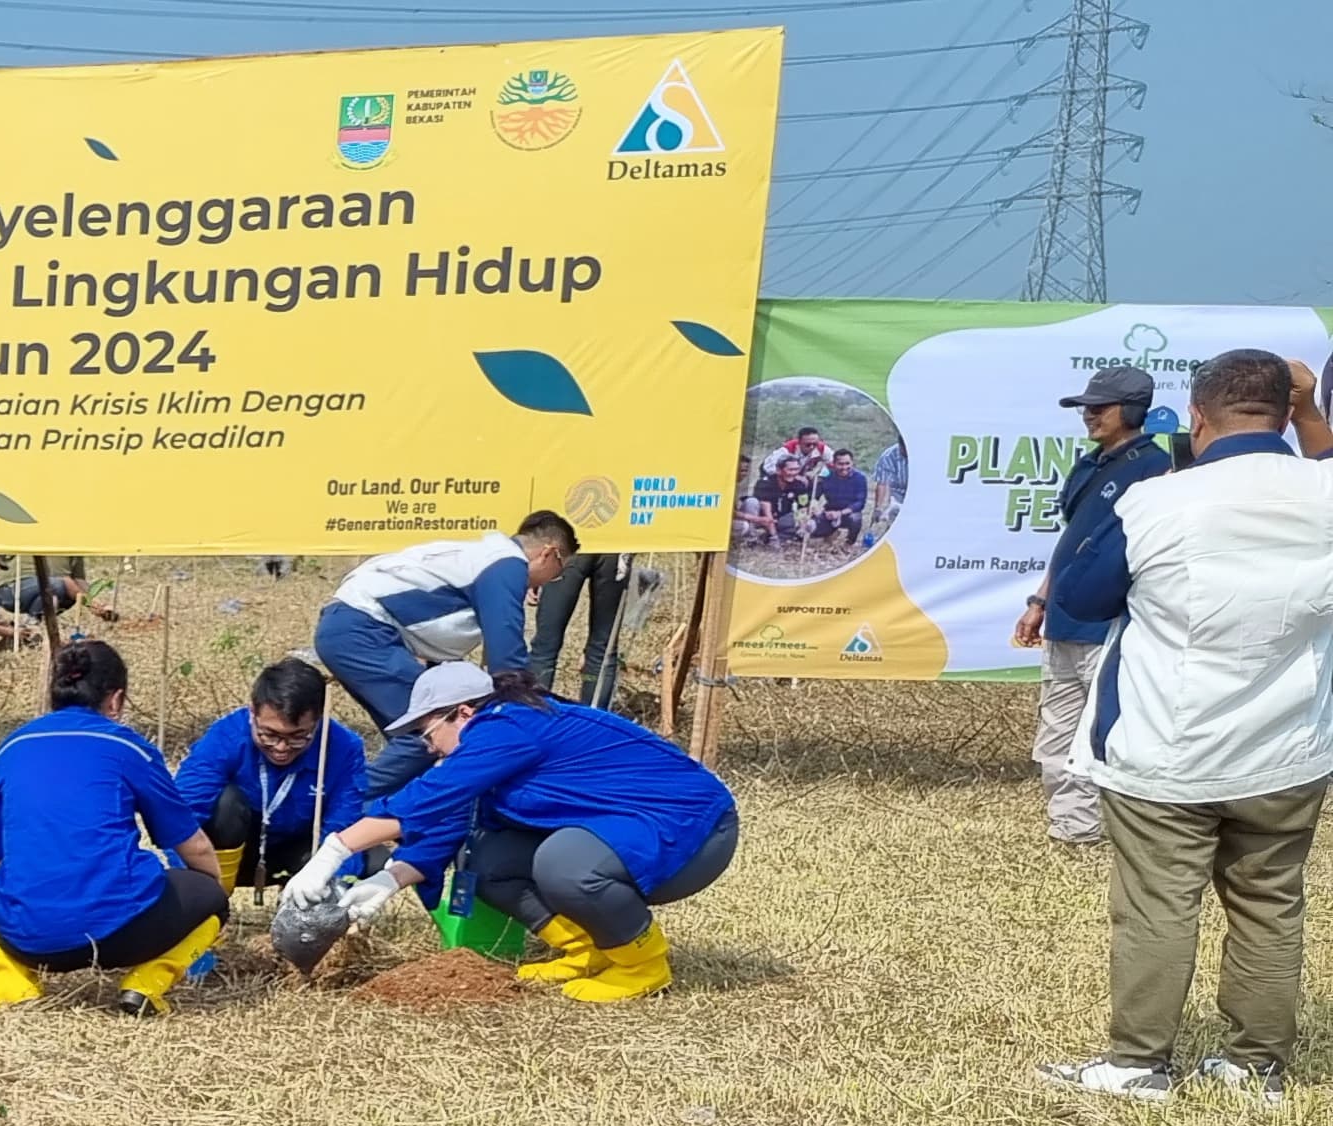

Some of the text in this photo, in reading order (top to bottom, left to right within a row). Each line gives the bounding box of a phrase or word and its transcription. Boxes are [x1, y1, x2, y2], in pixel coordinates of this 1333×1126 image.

[407, 87, 477, 99] PEMERINTAH
[406, 101, 472, 112] KABUPATEN
[405, 114, 444, 125] BEKASI
[607, 158, 727, 181] Deltamas
[12, 259, 381, 318] Lingkungan
[405, 245, 603, 304] Hidup
[69, 329, 217, 376] 2024
[69, 391, 149, 416] Krisis
[156, 389, 231, 415] Iklim
[240, 390, 366, 418] Dengan
[40, 426, 144, 456] Prinsip
[152, 424, 285, 450] keadilan
[327, 477, 501, 497] Our Land. Our Future
[633, 477, 676, 492] WORLD
[385, 499, 437, 515] We are
[631, 494, 721, 509] ENVIRONMENT
[629, 511, 654, 525] DAY
[1005, 488, 1068, 532] FE
[325, 516, 498, 532] #GenerationRestoration
[935, 556, 1046, 574] Dalam Rangka
[776, 605, 852, 616] SUPPORTED BY:
[839, 653, 883, 663] Deltamas
